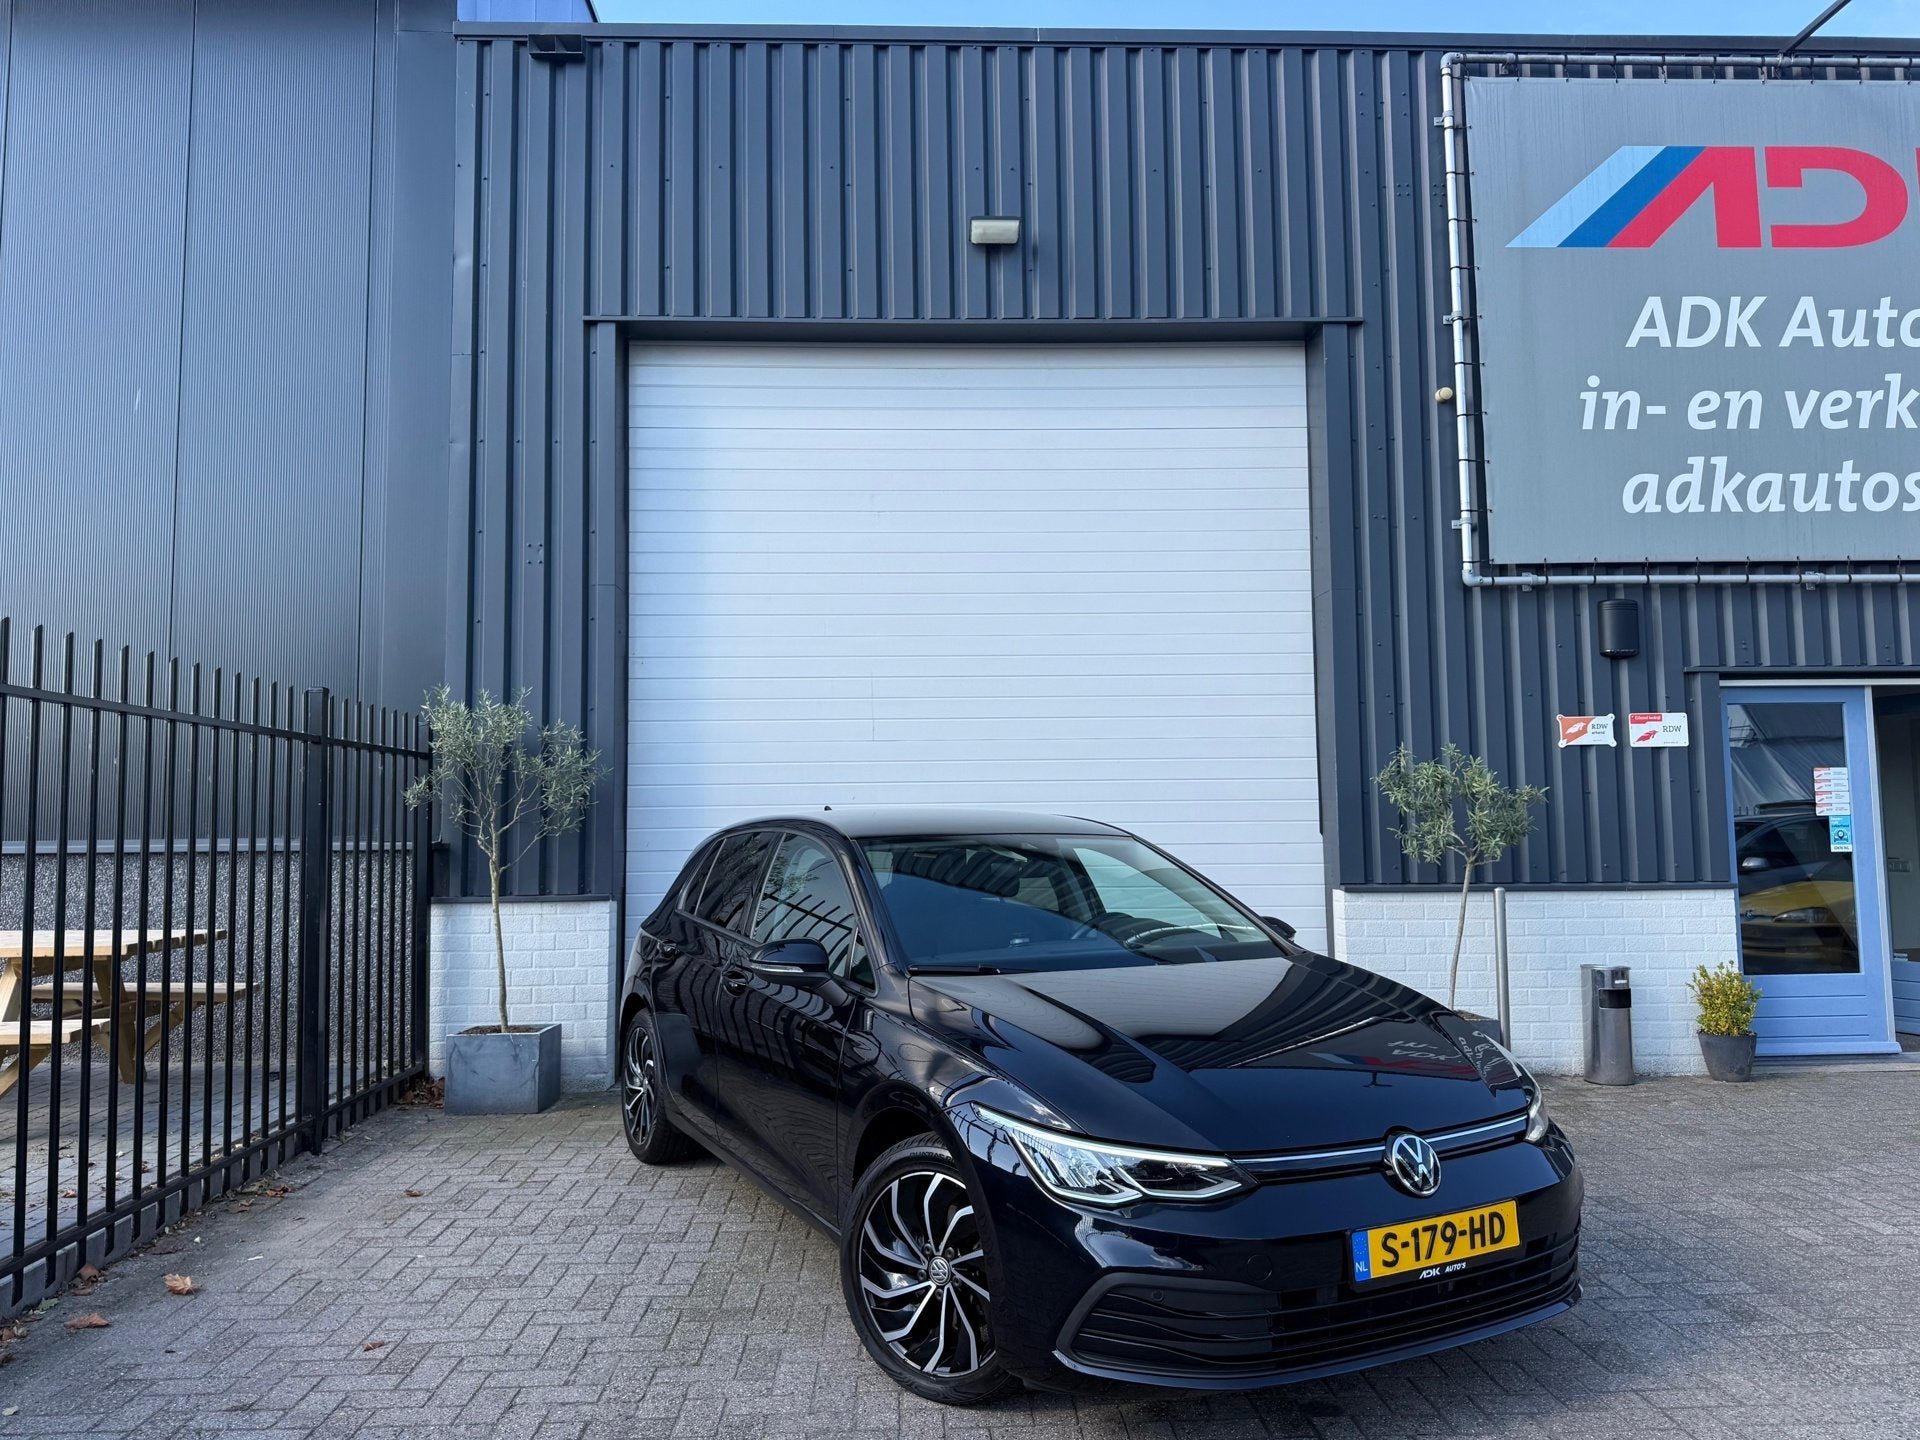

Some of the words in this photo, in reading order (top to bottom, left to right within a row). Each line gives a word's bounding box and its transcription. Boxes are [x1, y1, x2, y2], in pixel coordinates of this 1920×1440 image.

[1606, 145, 1920, 249] AD
[1625, 296, 1768, 348] ADK
[1579, 375, 1667, 430] in-
[1687, 388, 1763, 430] en
[1784, 373, 1920, 430] verk
[1381, 1211, 1506, 1268] S-179-HD
[1355, 1261, 1369, 1273] NL
[1418, 1266, 1441, 1280] ADK
